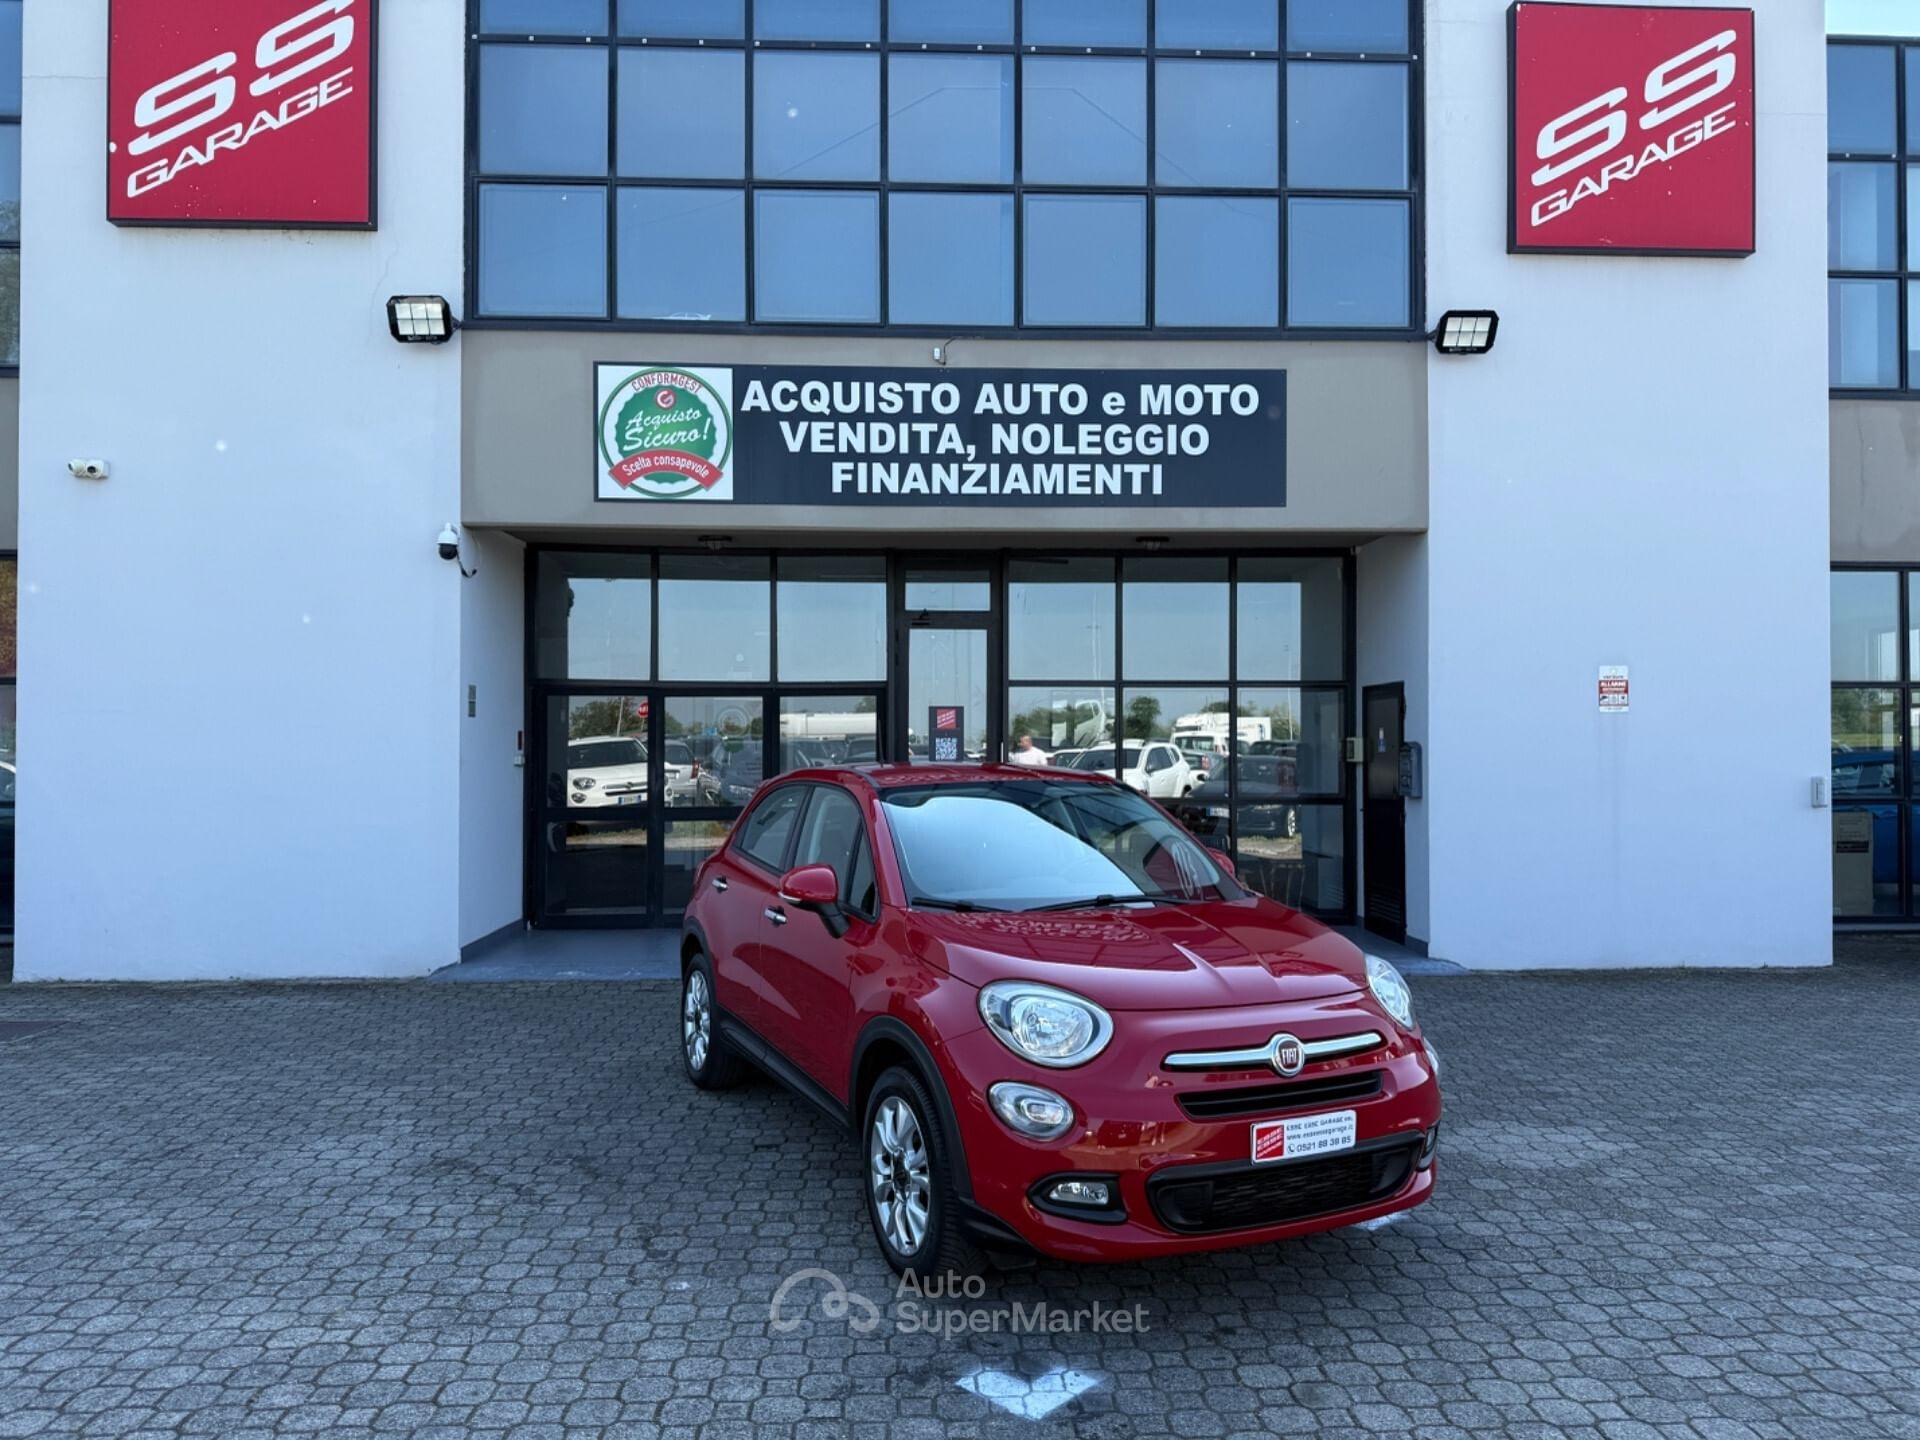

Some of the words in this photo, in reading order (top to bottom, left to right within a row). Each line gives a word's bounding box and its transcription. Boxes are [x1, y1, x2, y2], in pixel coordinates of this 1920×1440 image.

[127, 67, 353, 198] GARAGE
[1531, 102, 1736, 227] GARAGE
[741, 381, 960, 415] ACQUISTO
[974, 384, 1087, 414] AUTO
[1102, 392, 1126, 415] e
[1141, 384, 1259, 415] MOTO
[623, 417, 711, 451] Sicuro!
[625, 407, 702, 430] Acquisto
[780, 421, 975, 461] VENDITA,
[991, 424, 1209, 455] NOLEGGIO
[622, 457, 652, 476] Scelta
[654, 455, 710, 478] consapevole
[832, 462, 1163, 494] FINANZIAMENTI
[1296, 1141, 1316, 1153] 0521
